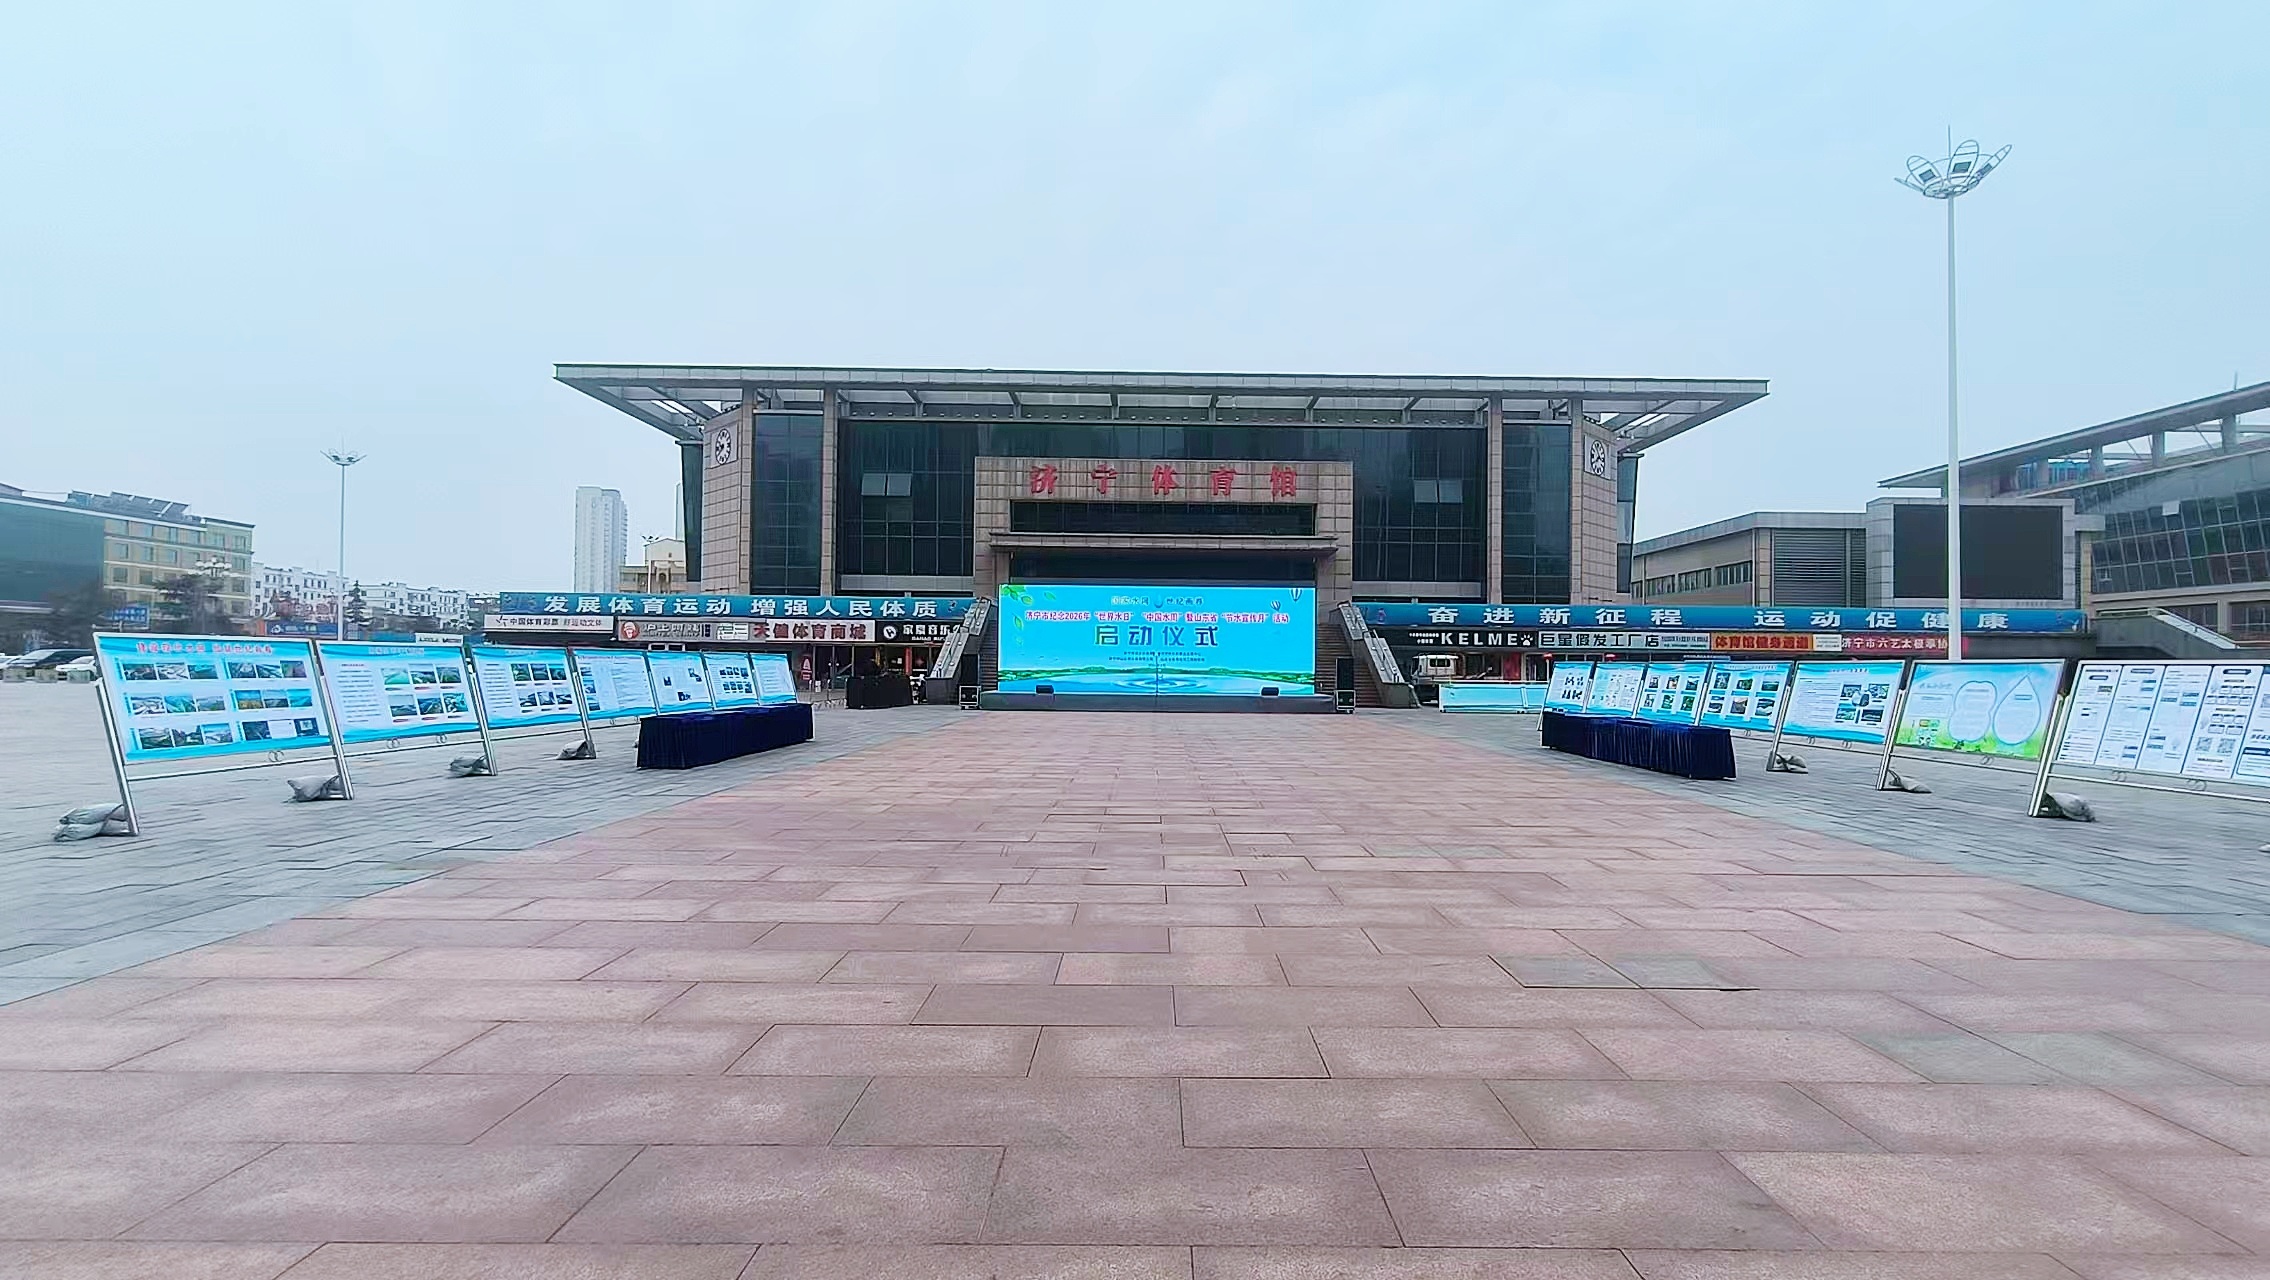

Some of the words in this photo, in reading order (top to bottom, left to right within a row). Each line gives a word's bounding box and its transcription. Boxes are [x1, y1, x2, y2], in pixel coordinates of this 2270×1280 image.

[1029, 464, 1297, 497] 济宁体育馆
[544, 596, 731, 615] 发展体育运动
[750, 598, 938, 618] 增强人民体质
[1428, 606, 1683, 626] 奋进新征程
[1753, 609, 2009, 629] 运动促健康
[510, 617, 559, 627] 中国体育彩票
[1095, 624, 1219, 646] 启动仪式
[1441, 632, 1521, 646] KELME
[1540, 632, 1661, 648] 巨星假发工厂店
